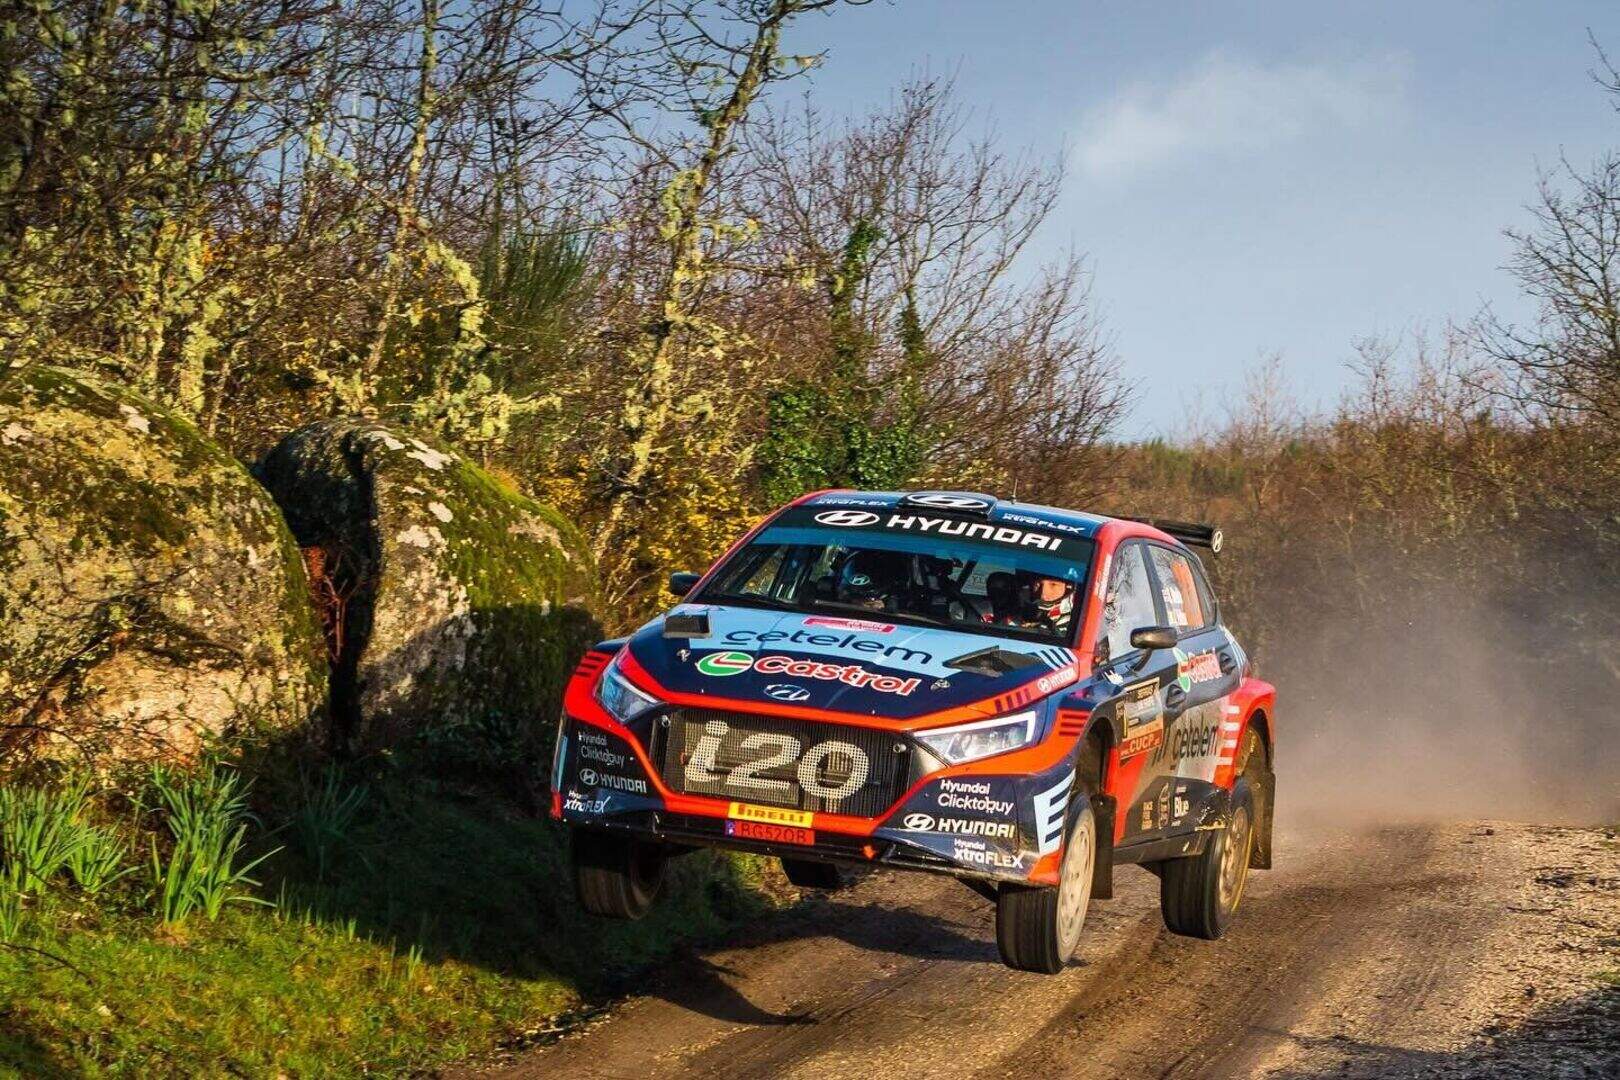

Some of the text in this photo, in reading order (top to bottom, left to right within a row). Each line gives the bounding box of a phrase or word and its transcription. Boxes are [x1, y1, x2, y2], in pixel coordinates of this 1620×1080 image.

[886, 515, 1064, 551] HYUNDAI
[721, 624, 933, 665] cetelem
[753, 655, 922, 697] Castrol
[685, 719, 869, 802] i20
[600, 774, 648, 793] HYUNDAI
[940, 779, 991, 794] Hyundai
[737, 804, 804, 823] PIRELLI
[938, 818, 1015, 838] HYUNDAI
[954, 848, 1023, 869] xtraFLEX
